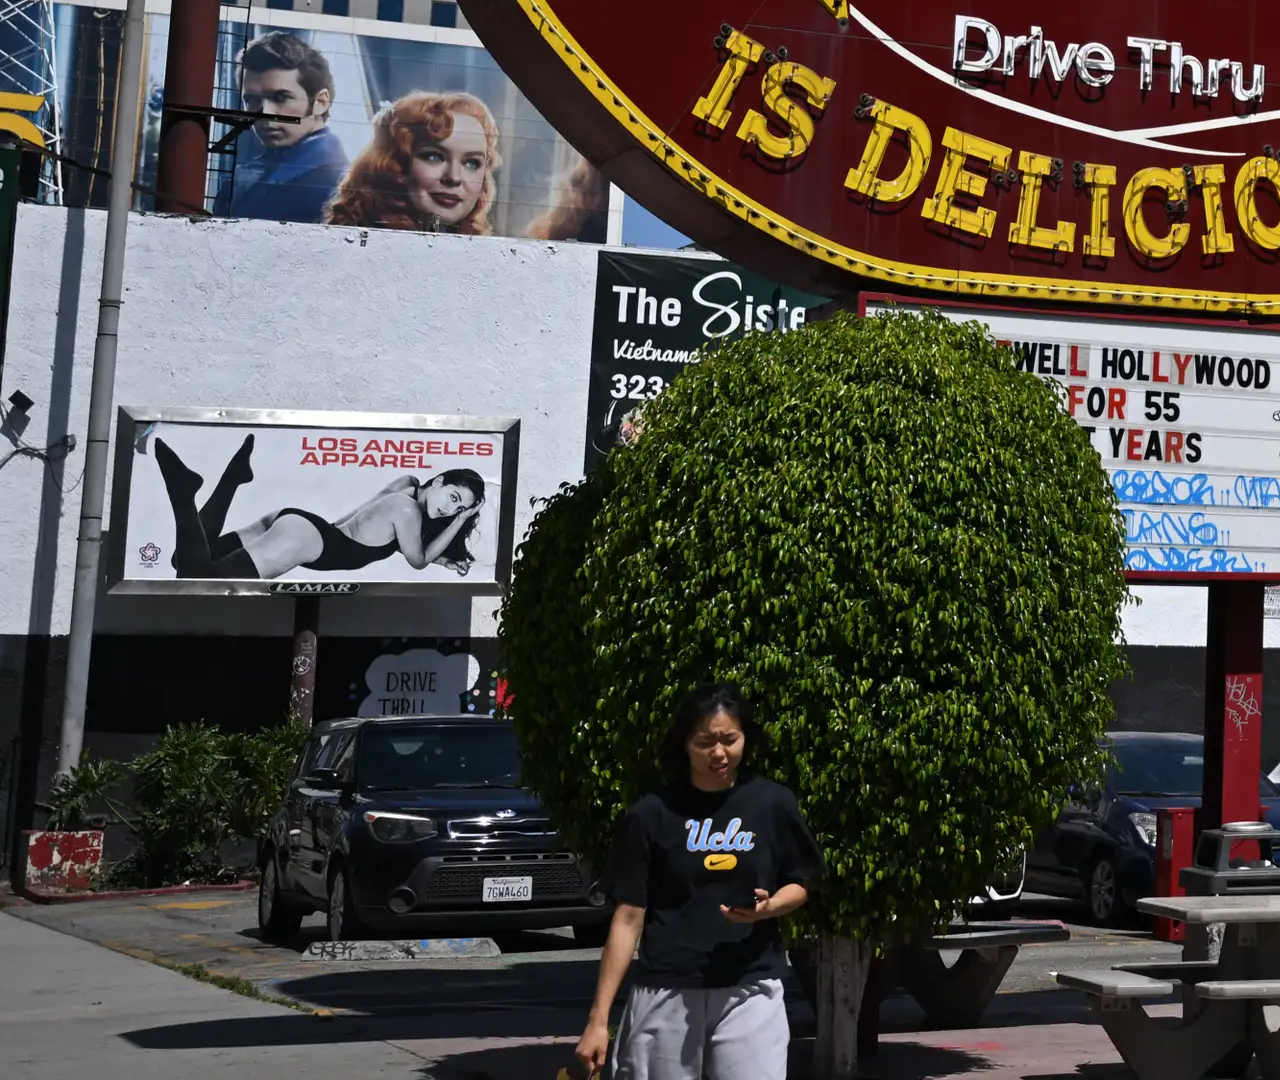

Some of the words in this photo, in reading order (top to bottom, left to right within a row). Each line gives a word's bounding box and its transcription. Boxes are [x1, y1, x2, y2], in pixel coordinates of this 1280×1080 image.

[953, 15, 1114, 88] Drive
[1127, 37, 1265, 102] Thru
[691, 26, 836, 160] IS
[612, 285, 682, 327] The
[996, 340, 1088, 377] WELL
[1102, 347, 1271, 389] HOLLYWOOD
[1068, 385, 1127, 420] FOR
[1145, 391, 1180, 422] 55
[300, 452, 432, 468] APPAREL
[302, 437, 357, 452] LOS
[363, 439, 494, 457] ANGELES
[1109, 427, 1202, 463] YEARS
[276, 583, 351, 593] LAMAR
[386, 672, 437, 692] DRIVE
